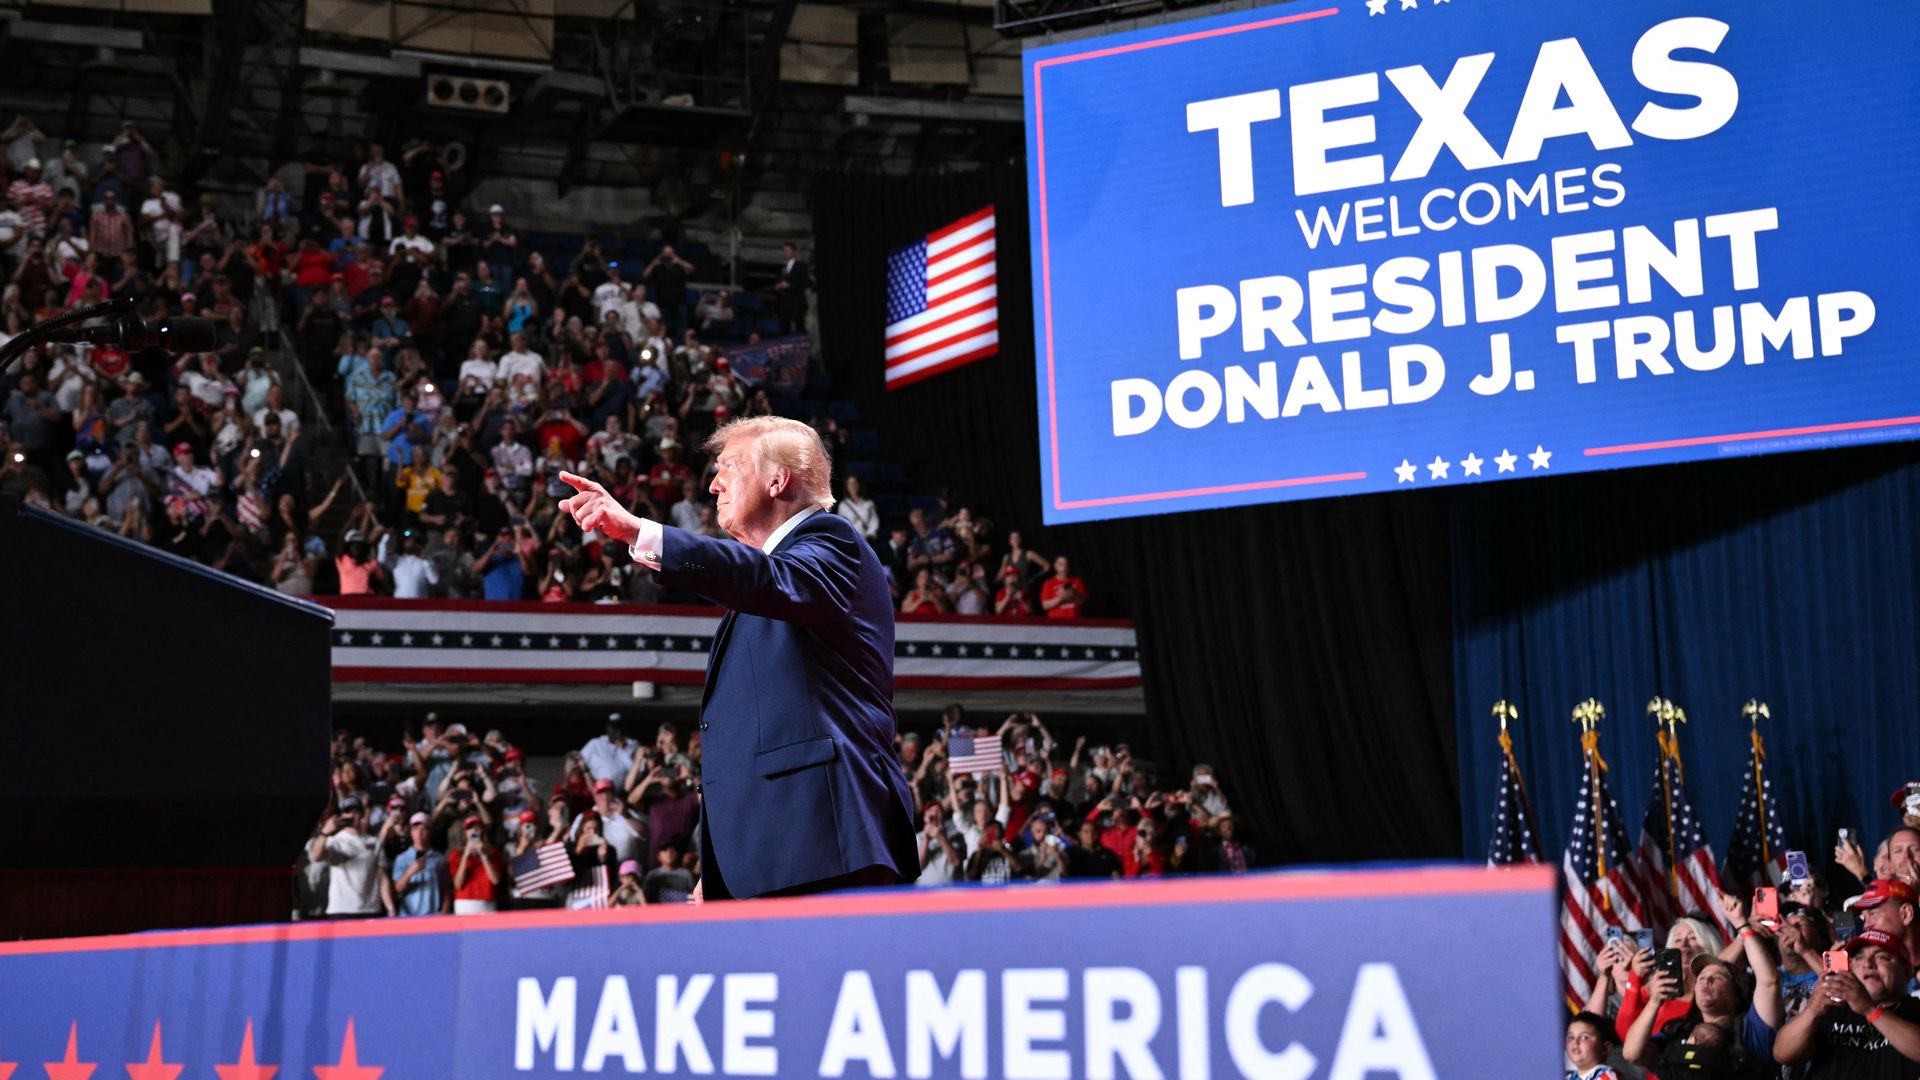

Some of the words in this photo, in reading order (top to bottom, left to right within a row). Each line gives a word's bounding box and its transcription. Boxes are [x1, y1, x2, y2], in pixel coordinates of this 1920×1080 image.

[1186, 16, 1739, 208] TEXAS
[1294, 162, 1626, 250] WELCOMES
[1176, 207, 1779, 361] PRESIDENT
[1110, 343, 1446, 437] DONALD
[1468, 332, 1537, 396] J.
[1555, 290, 1876, 386] TRUMP
[514, 972, 779, 1076] MAKE
[818, 962, 1437, 1080] AMERICA
[1832, 1021, 1867, 1034] MAK
